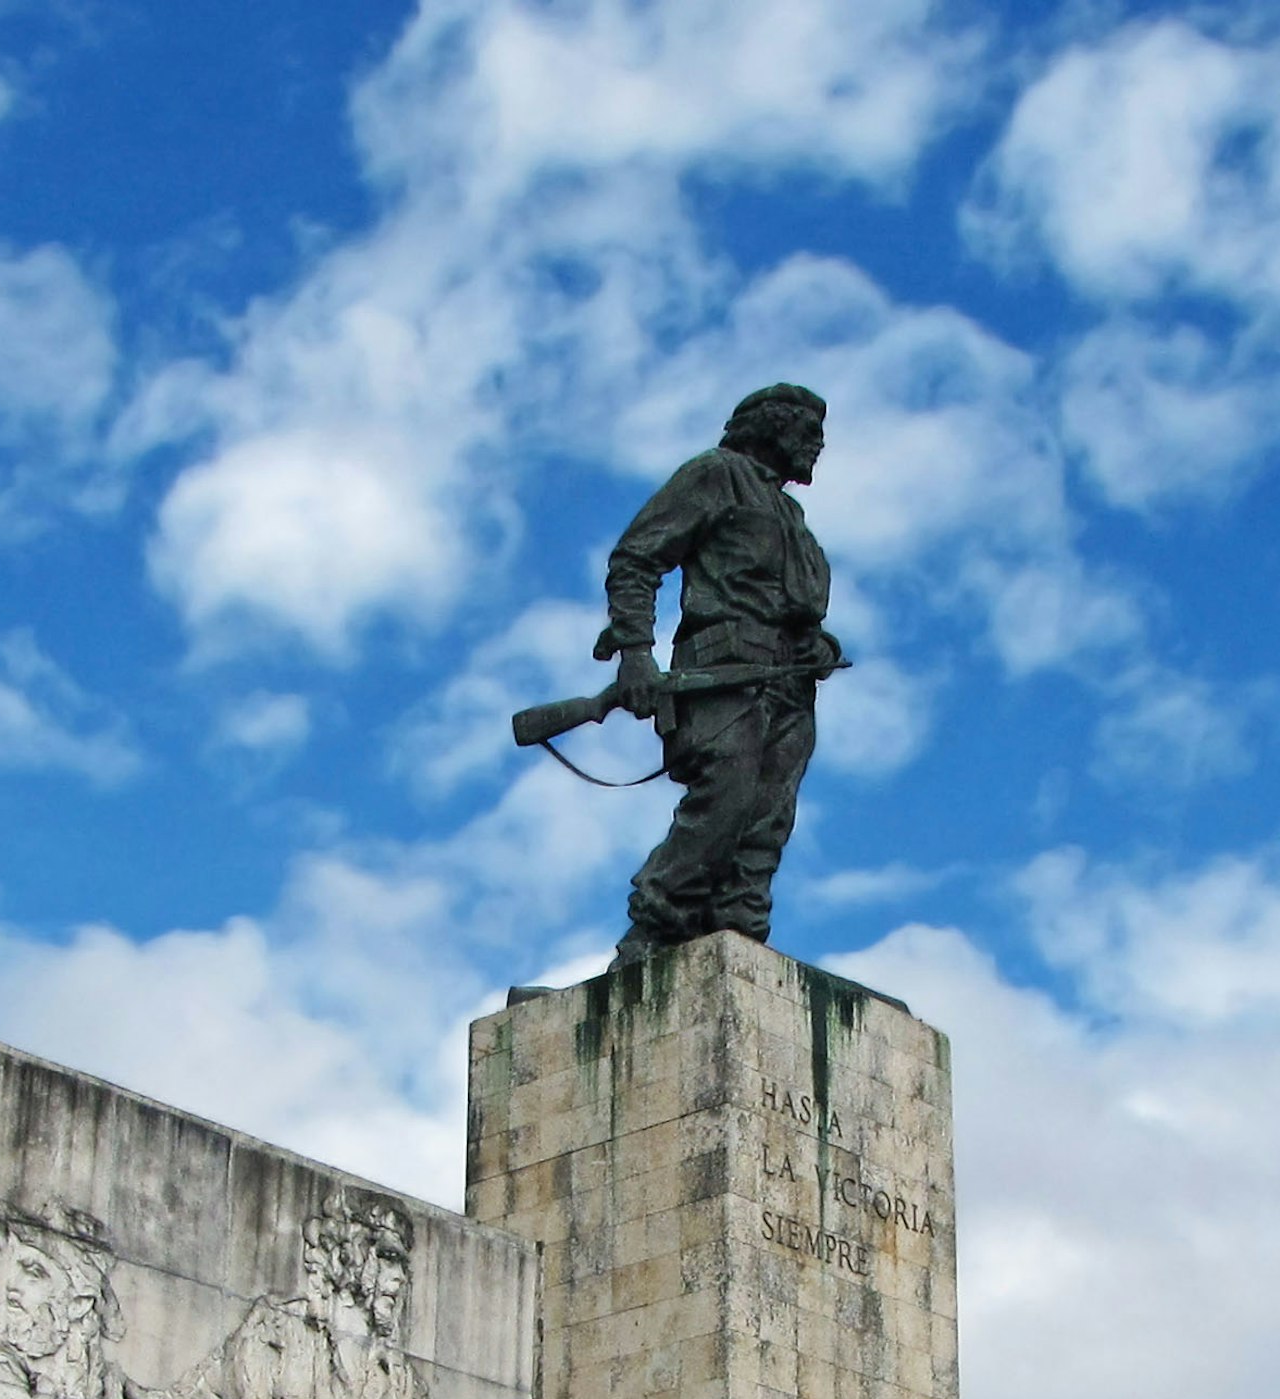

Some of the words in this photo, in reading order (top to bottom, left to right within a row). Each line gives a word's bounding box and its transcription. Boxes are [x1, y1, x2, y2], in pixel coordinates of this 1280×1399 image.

[762, 1144, 796, 1182] LA
[815, 1164, 934, 1238] VICTORIA
[762, 1211, 868, 1276] SIEMPRE
